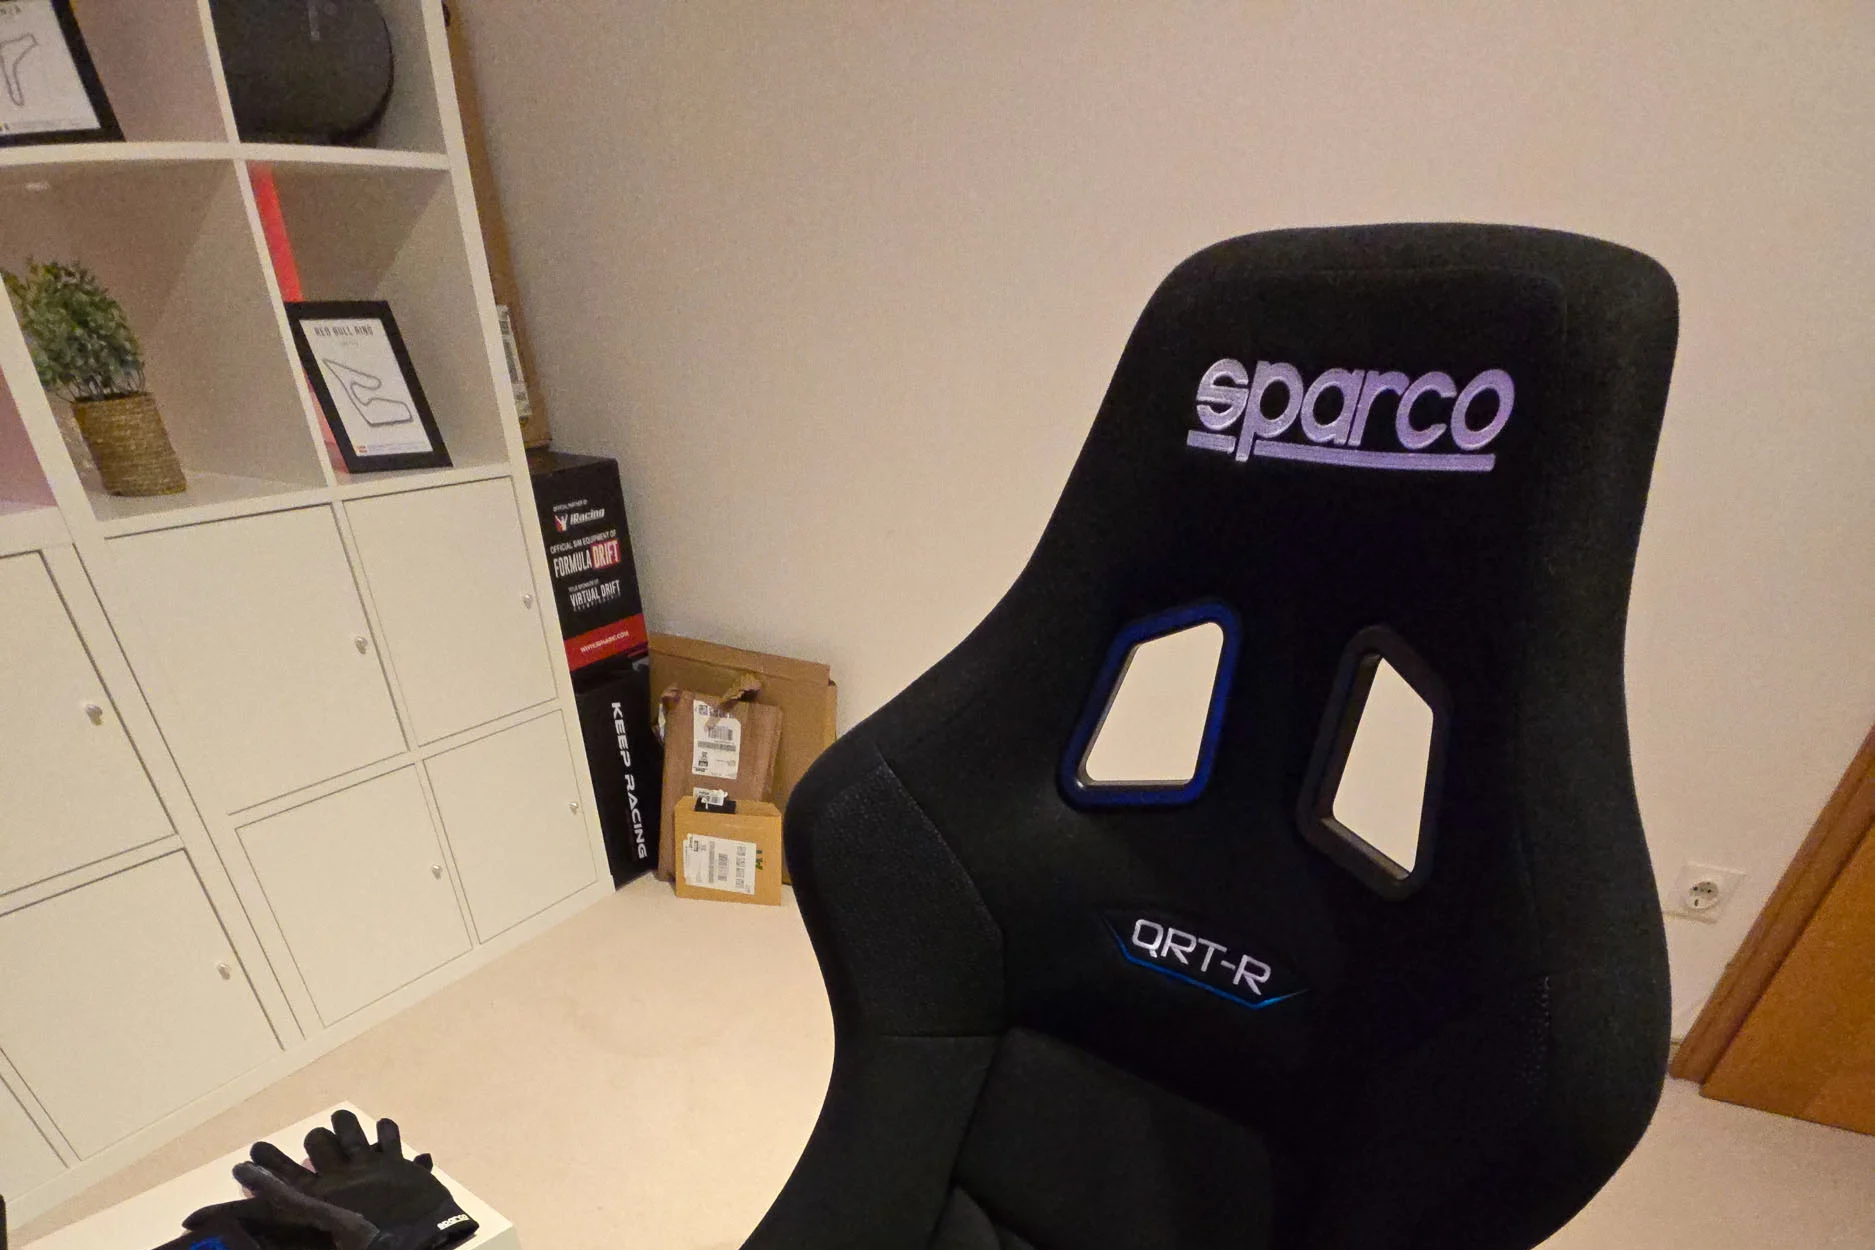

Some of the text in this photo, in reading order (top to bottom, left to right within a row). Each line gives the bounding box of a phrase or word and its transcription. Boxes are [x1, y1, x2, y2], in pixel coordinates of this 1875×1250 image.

[1190, 358, 1515, 468] sparco
[550, 542, 573, 554] OFFICIAL
[553, 540, 619, 578] FORMULA DRIFT
[570, 587, 601, 607] VIRTUAL
[600, 580, 620, 597] DRIFT
[611, 702, 647, 859] KEEP RACING
[1132, 918, 1271, 995] QRT-R
